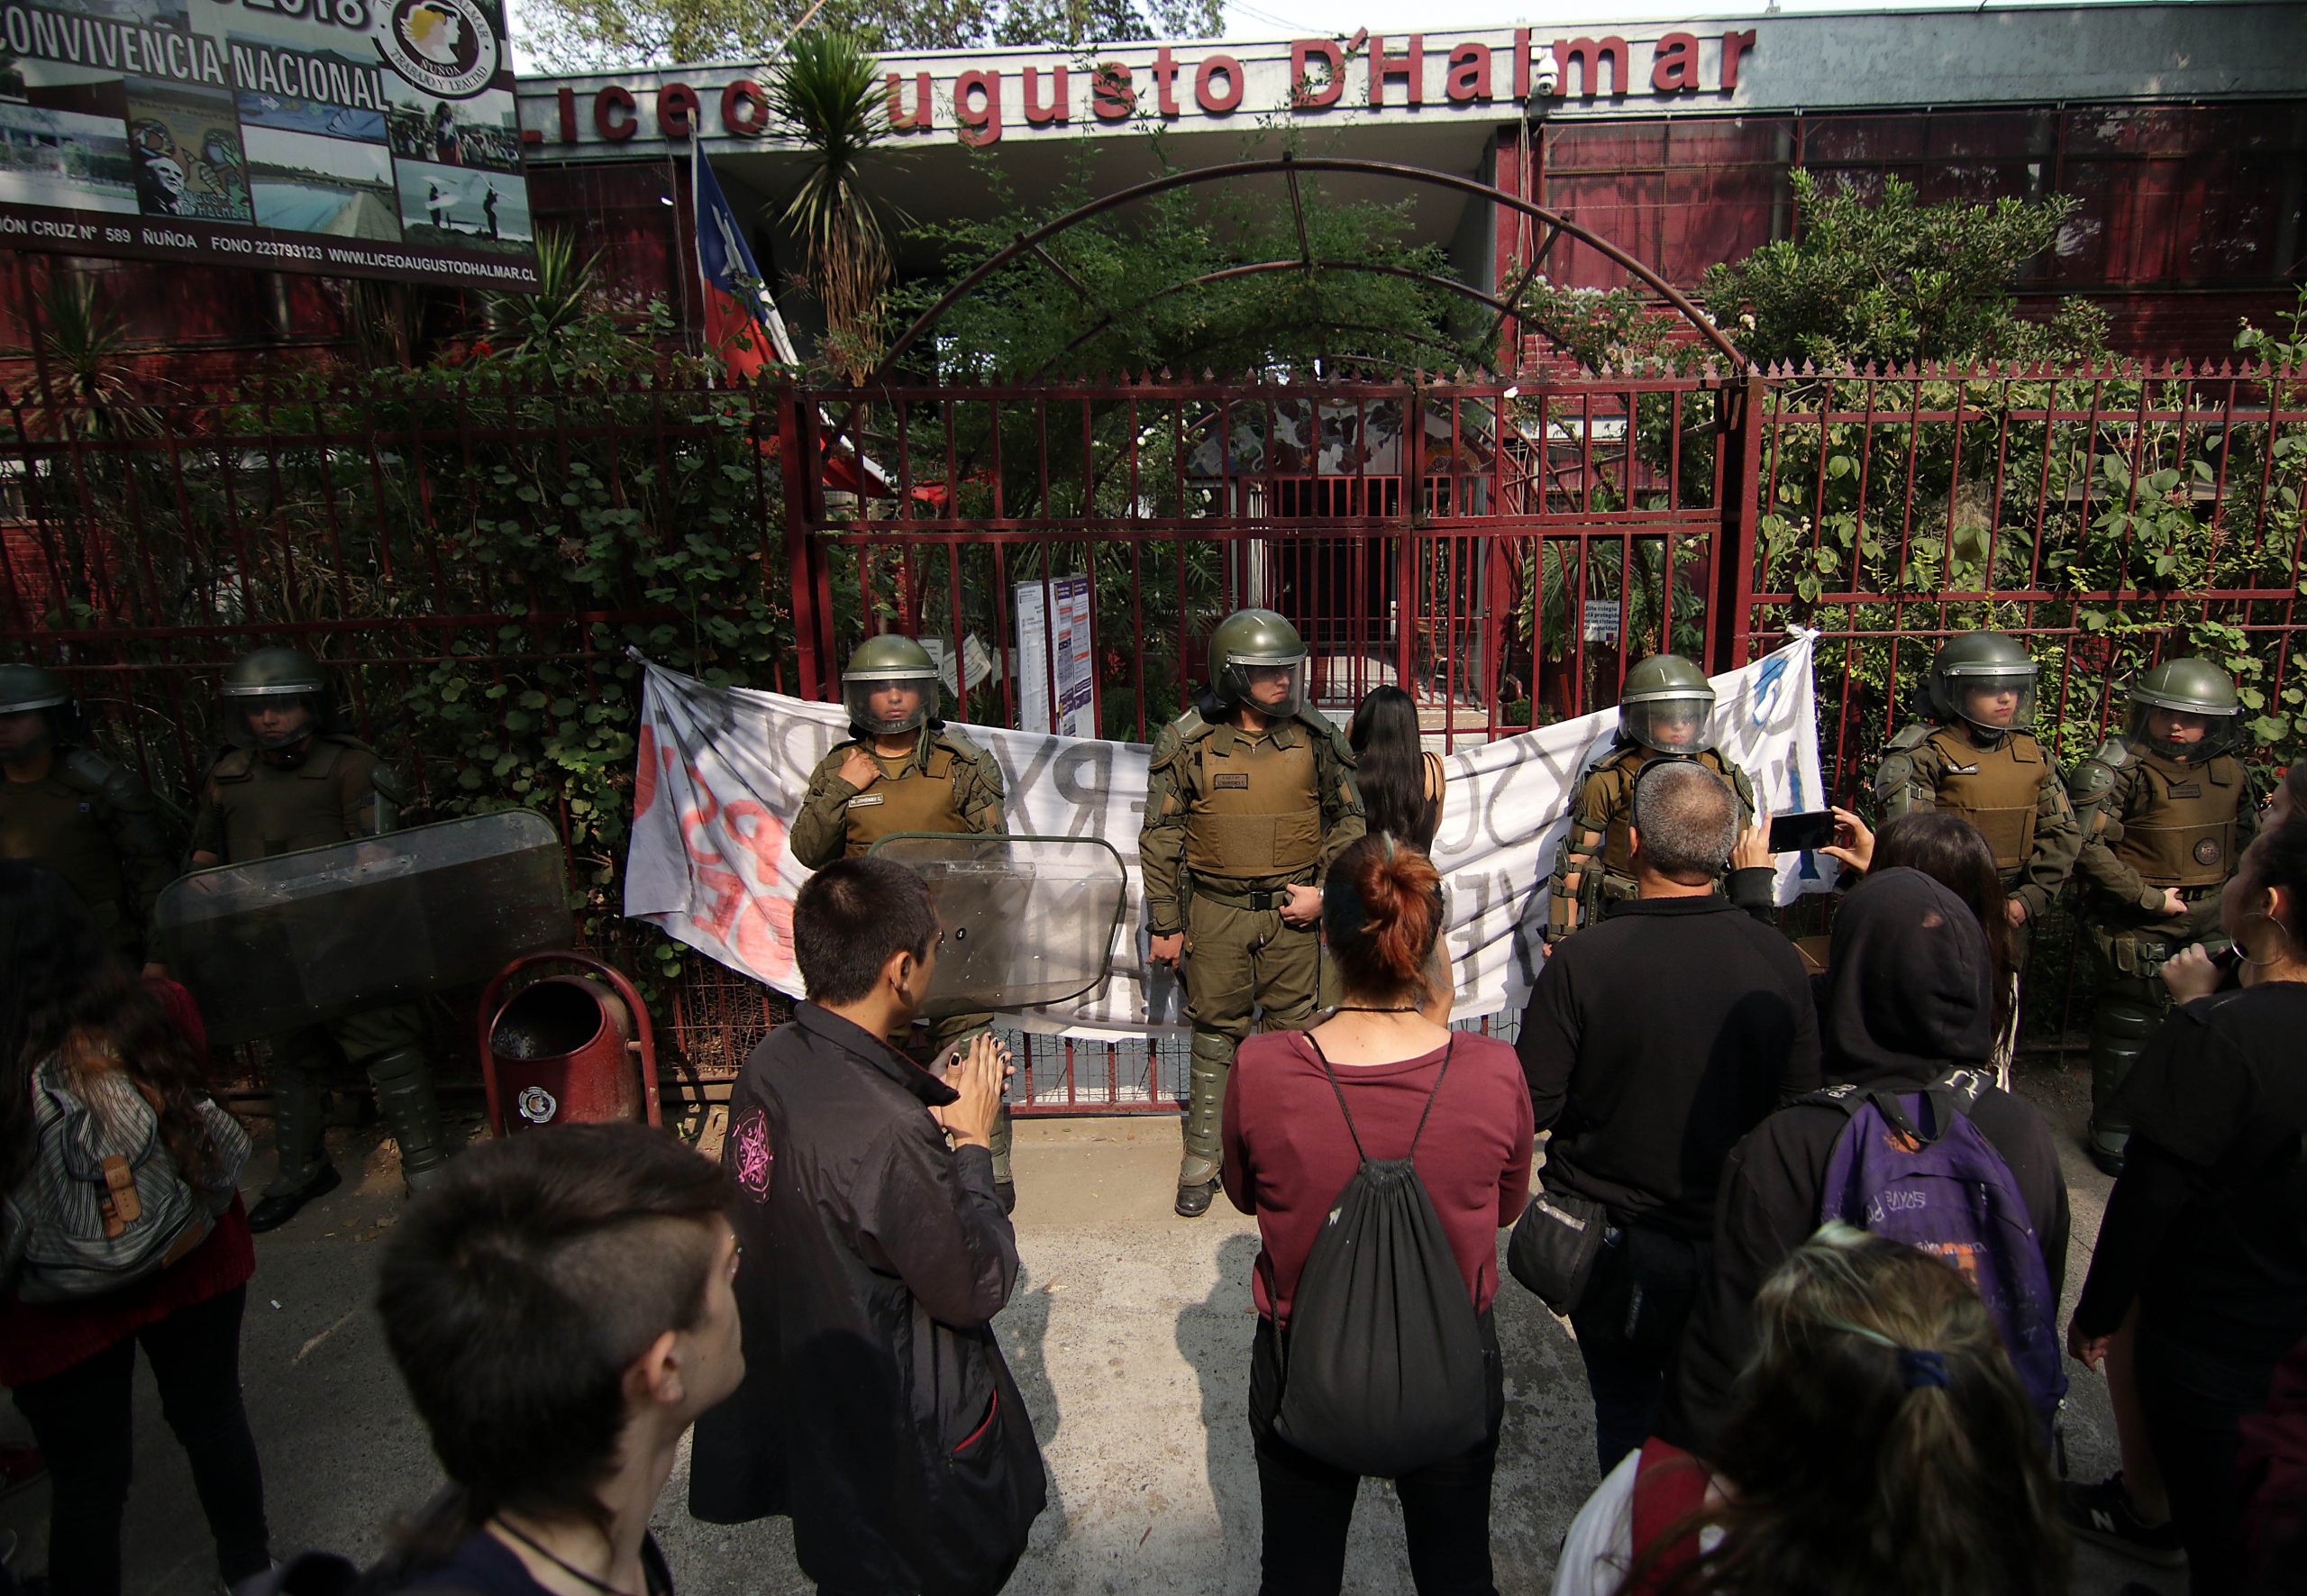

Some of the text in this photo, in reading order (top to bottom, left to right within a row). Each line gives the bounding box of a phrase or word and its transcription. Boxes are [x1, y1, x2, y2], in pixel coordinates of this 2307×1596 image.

[232, 45, 390, 111] NACIONAL
[391, 48, 488, 91] TRABAJO Y LEALTAD
[522, 79, 769, 142] iceo
[887, 46, 1245, 146] ugusto
[0, 215, 27, 234] ÓN
[32, 220, 77, 239] CRUZ
[105, 227, 131, 243] 589
[142, 229, 197, 249] ÑUÑOA
[211, 236, 252, 253] FONO
[255, 241, 323, 260] 223793123
[328, 248, 537, 282] WWW.LICEOAUGUSTODHALMAR.CL
